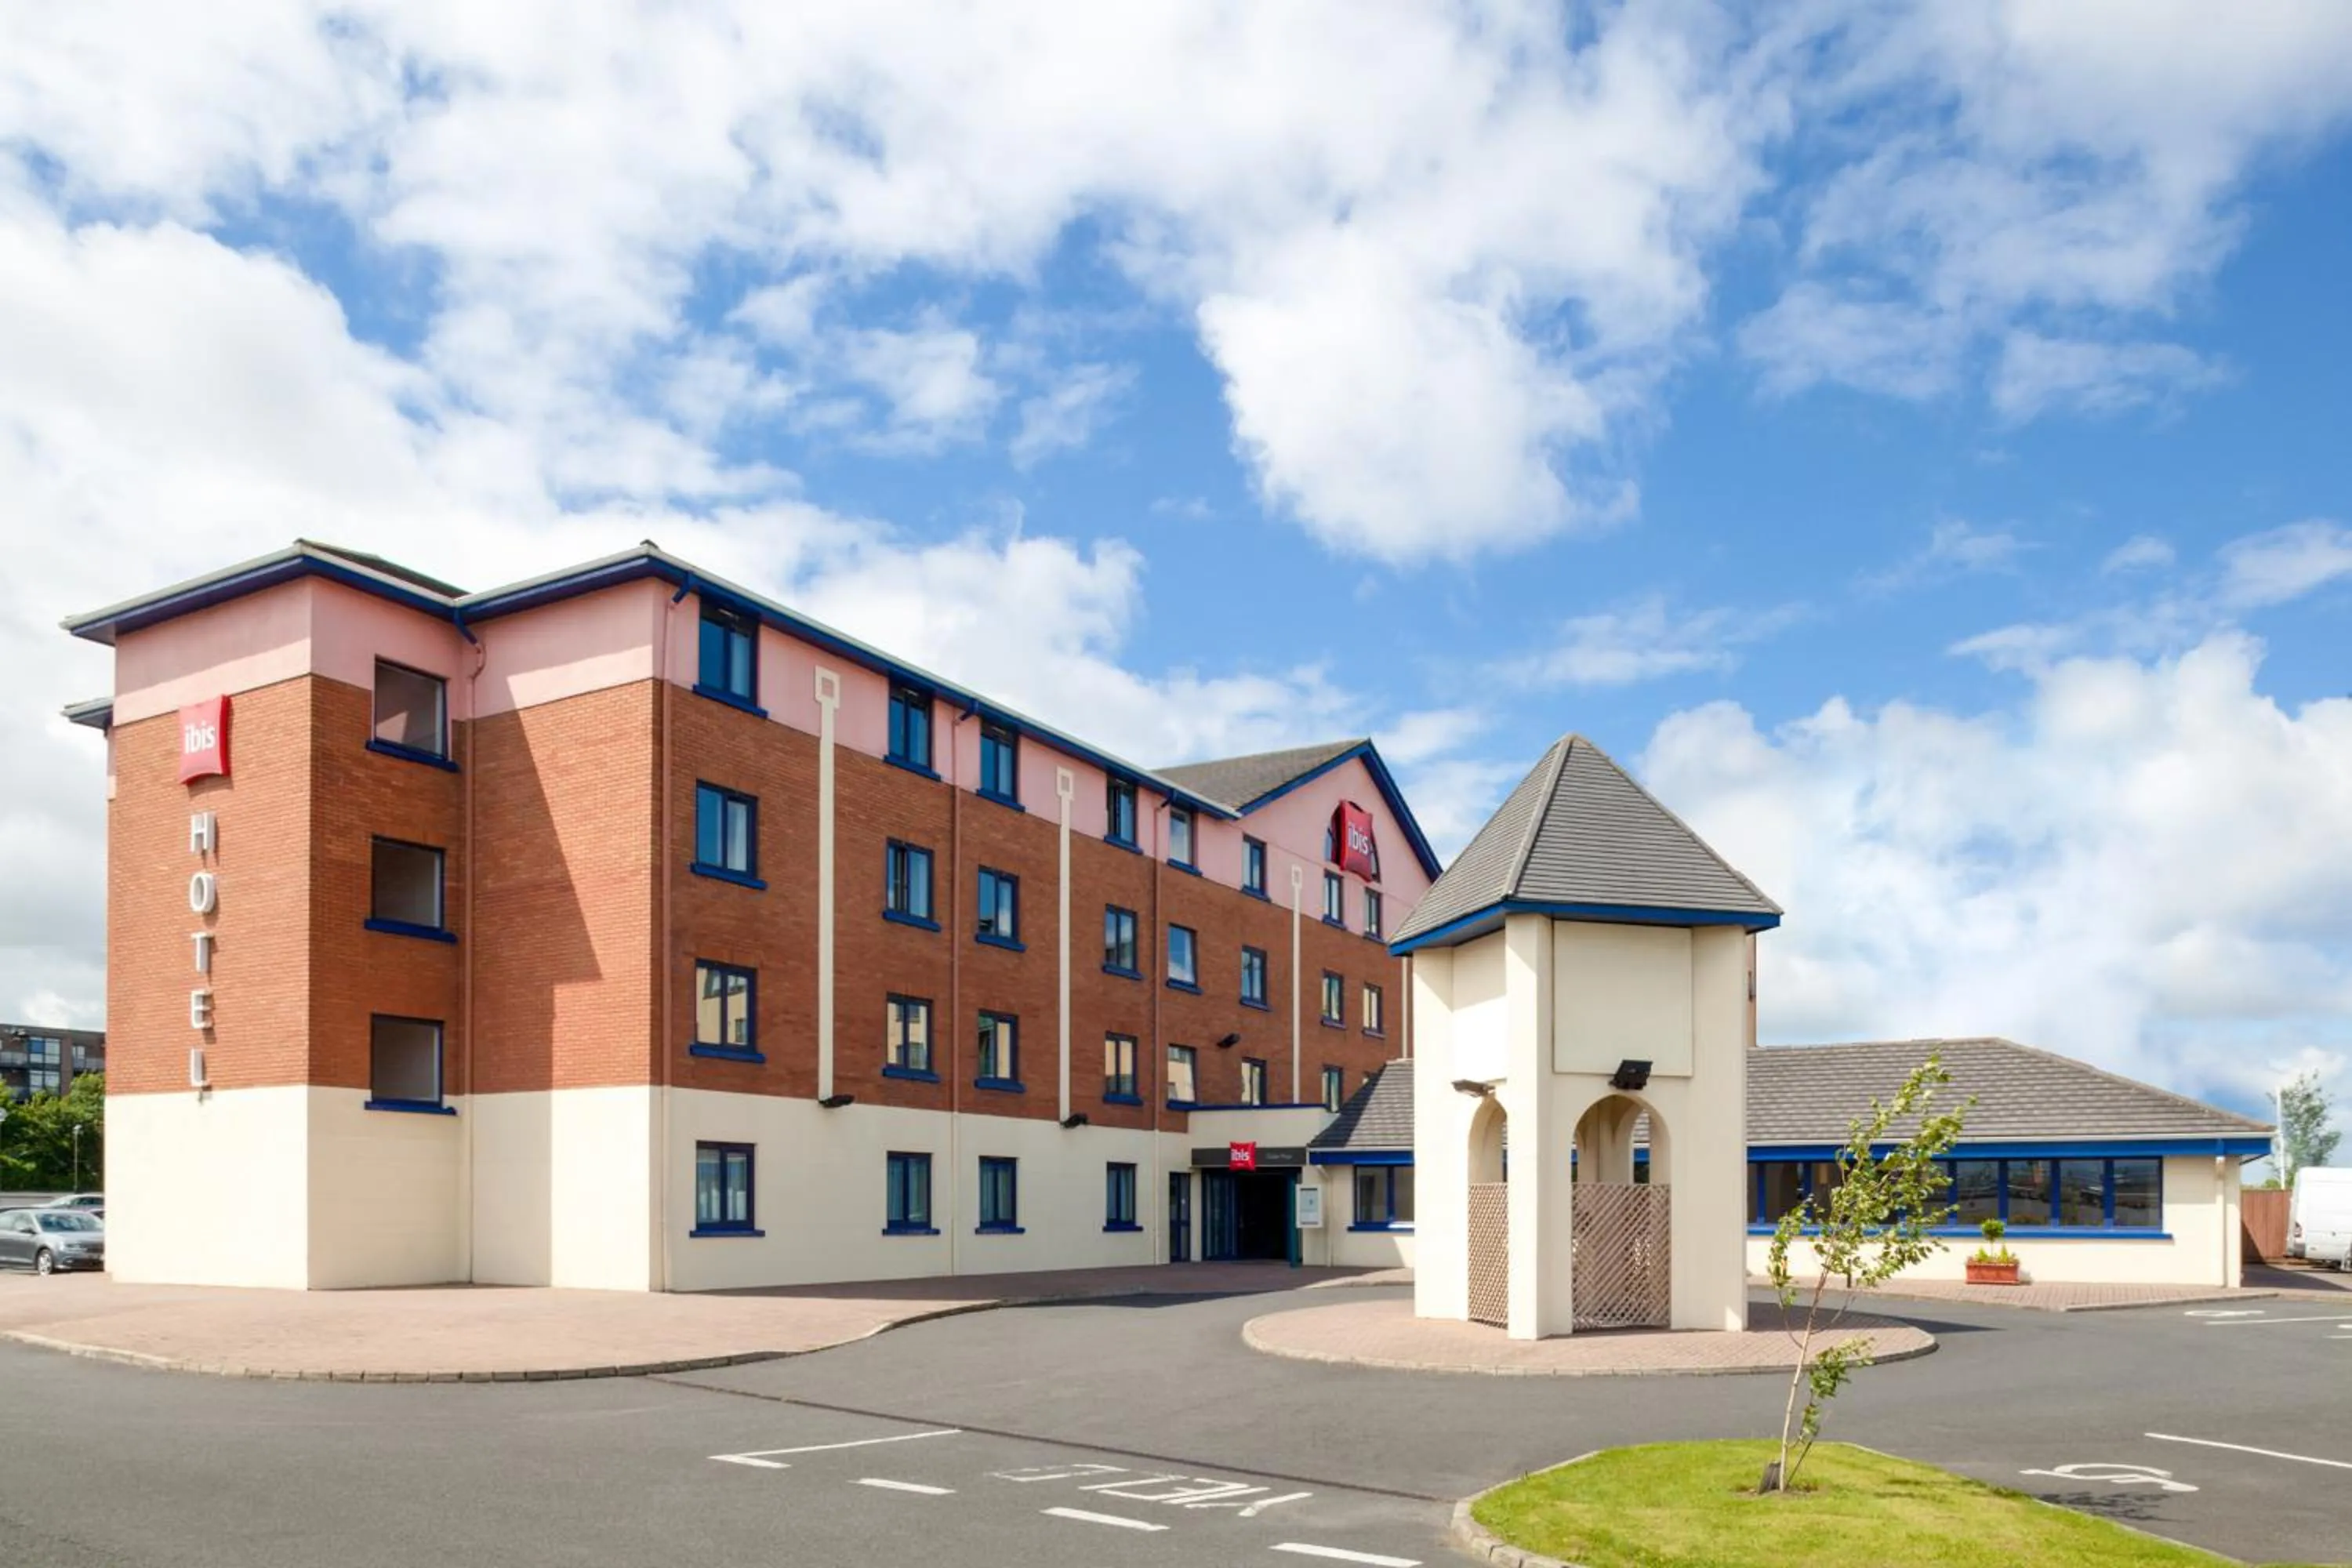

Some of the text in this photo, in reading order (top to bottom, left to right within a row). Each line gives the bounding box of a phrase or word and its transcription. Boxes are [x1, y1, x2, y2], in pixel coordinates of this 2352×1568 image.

[185, 720, 215, 753] ibis
[1348, 822, 1369, 855] ibis
[190, 811, 215, 1087] HOTEL
[1231, 1149, 1250, 1160] ibis
